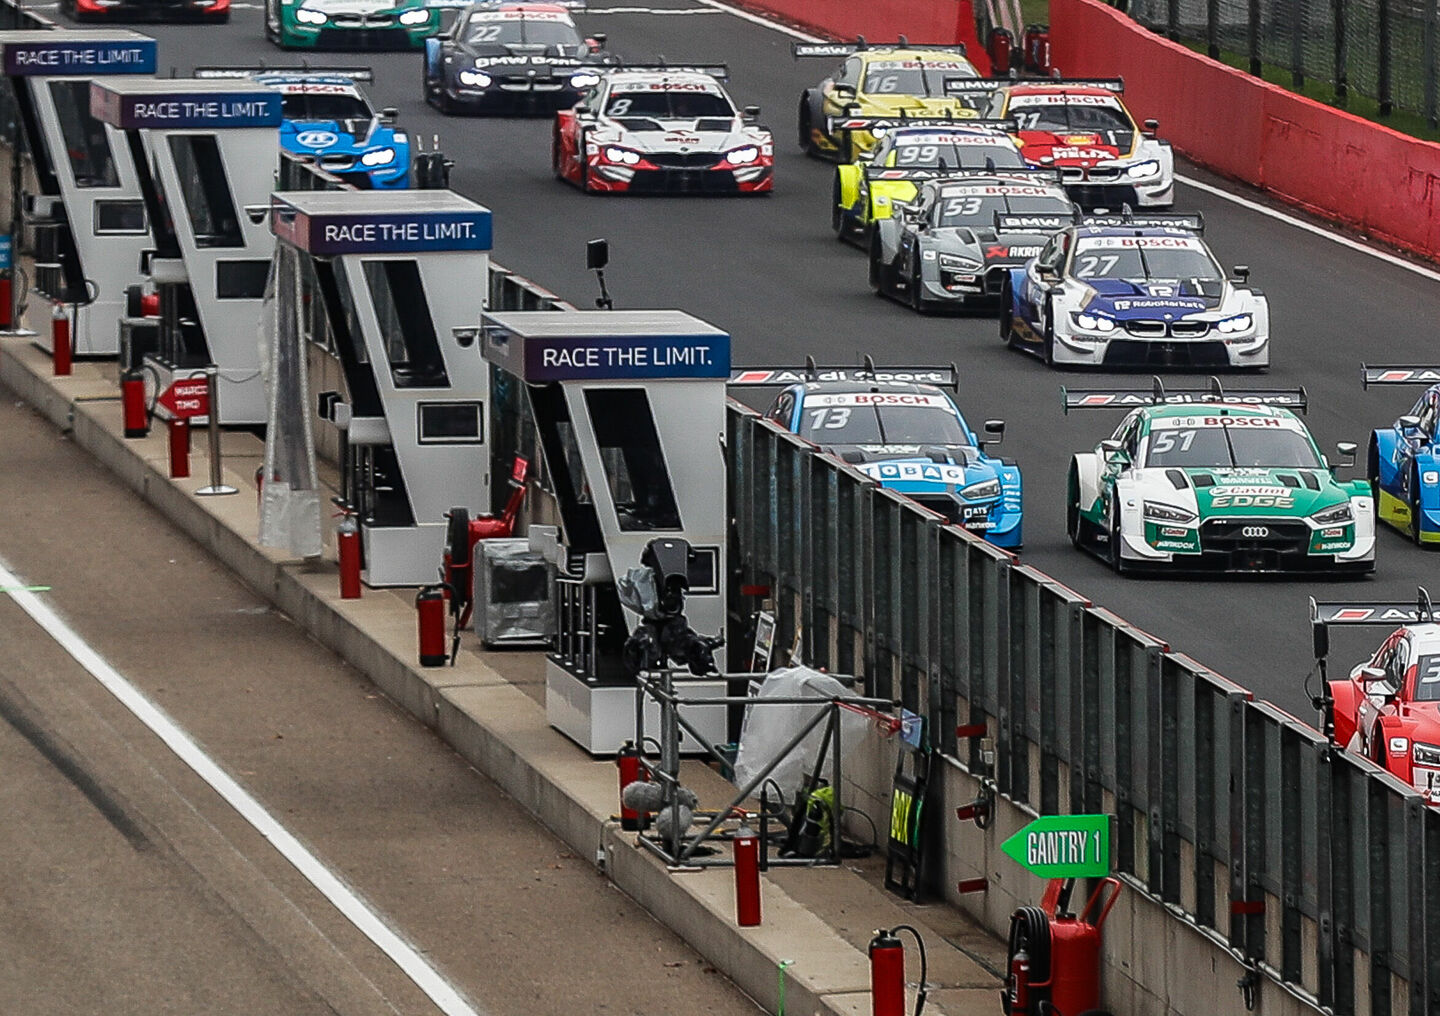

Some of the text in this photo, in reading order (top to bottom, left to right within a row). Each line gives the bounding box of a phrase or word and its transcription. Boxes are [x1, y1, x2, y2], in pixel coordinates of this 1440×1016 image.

[504, 12, 558, 20] BOSCH
[469, 26, 501, 43] 22
[16, 49, 144, 64] RACE THE LIMIT.
[475, 56, 528, 68] BMW
[902, 61, 959, 70] BOSCH
[288, 85, 346, 93] BOSCH
[650, 83, 707, 92] BOSCH
[866, 75, 898, 94] 16
[950, 80, 999, 89] BMW
[607, 98, 634, 116] 8
[1047, 96, 1107, 105] BOSCH
[134, 101, 271, 118] RACE THE LIMIT.
[938, 135, 997, 145] BOSCH
[900, 145, 939, 164] 99
[985, 186, 1048, 196] BOSCH
[943, 197, 983, 217] 53
[1005, 218, 1061, 227] BMW
[324, 222, 477, 242] RACE THE LIMIT.
[1121, 238, 1189, 248] BOSCH
[1008, 245, 1044, 258] AKRA
[1076, 255, 1120, 278] 27
[542, 345, 713, 368] RACE THE LIMIT.
[854, 395, 930, 406] BOSCH
[810, 408, 852, 430] 13
[1203, 416, 1281, 427] BOSCH
[1152, 430, 1198, 454] 51
[863, 464, 960, 480] TOBAG
[1231, 486, 1286, 495] Castrol
[1211, 495, 1295, 509] EDGE
[1027, 830, 1101, 865] GANTRY 1
